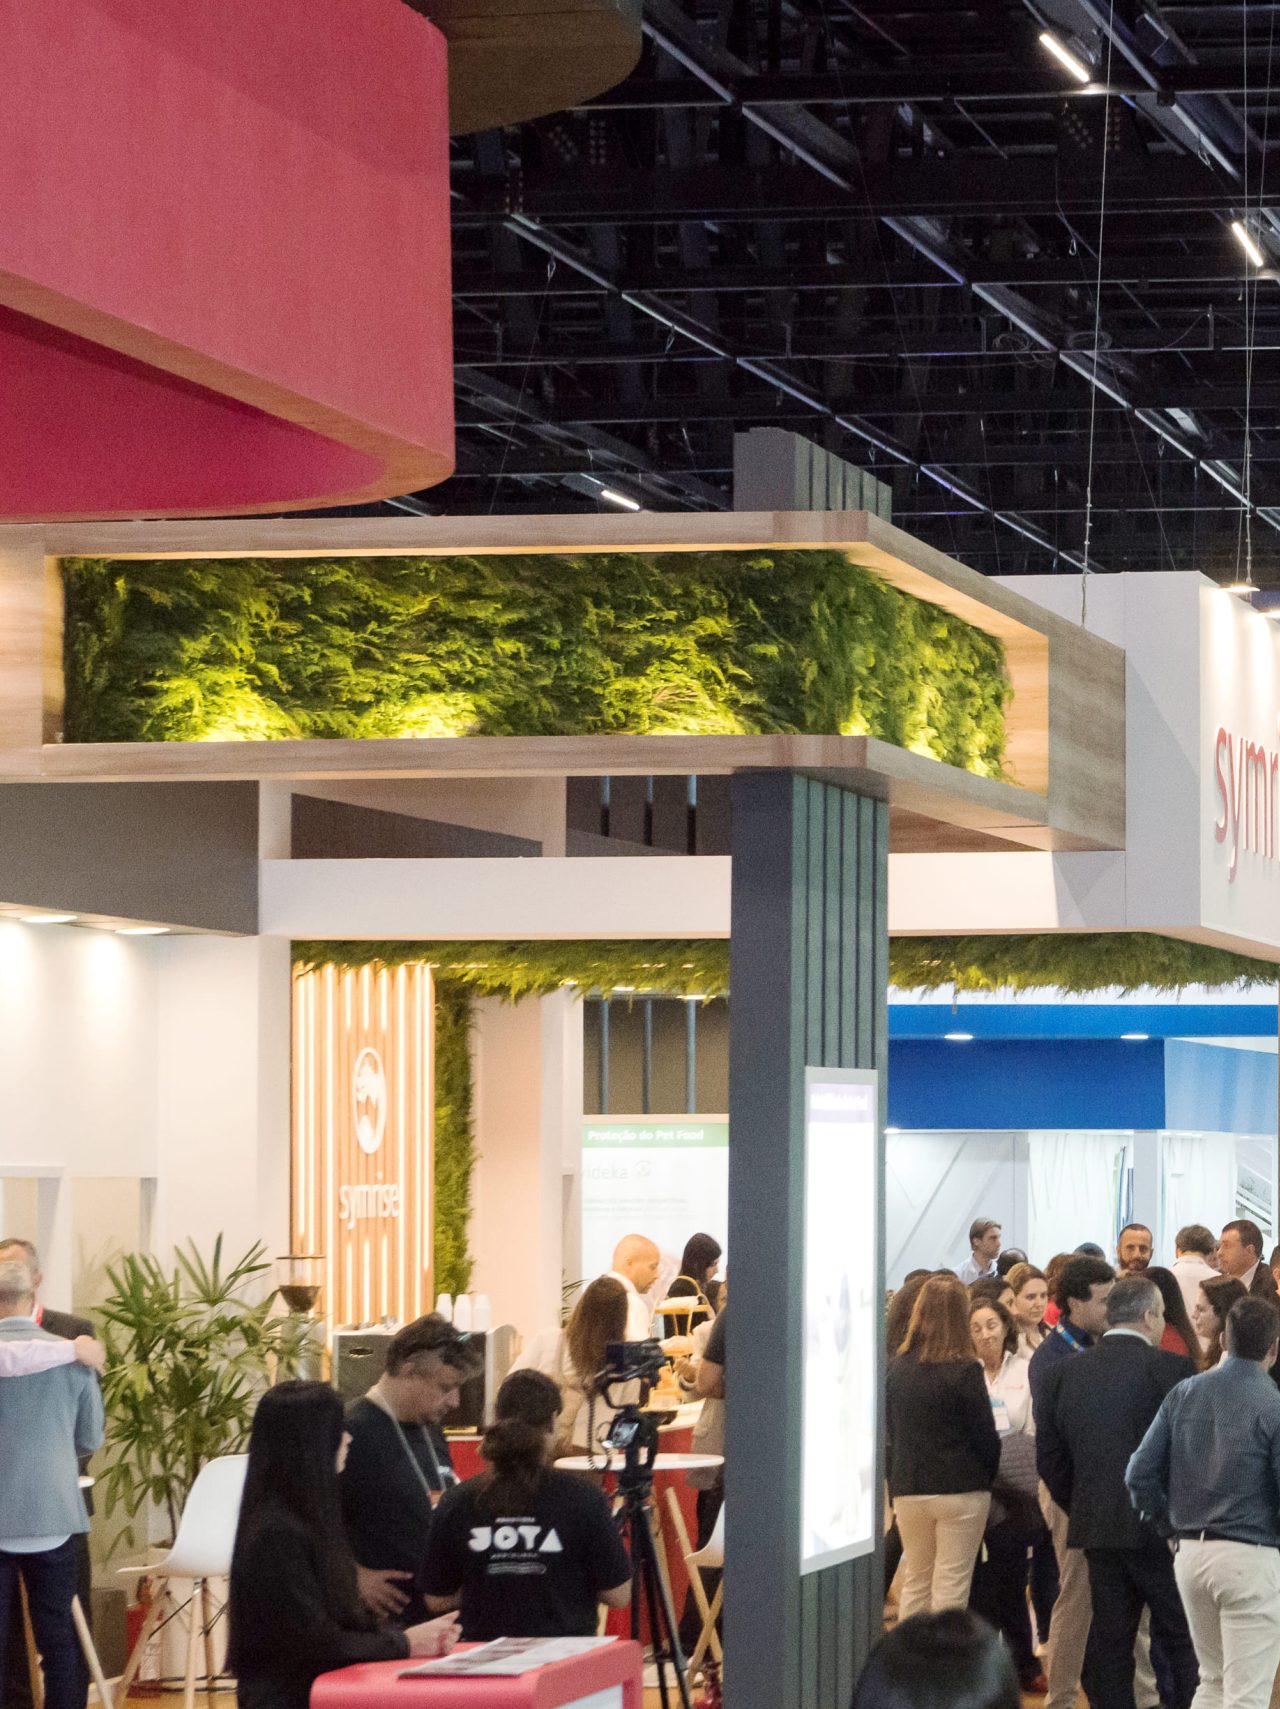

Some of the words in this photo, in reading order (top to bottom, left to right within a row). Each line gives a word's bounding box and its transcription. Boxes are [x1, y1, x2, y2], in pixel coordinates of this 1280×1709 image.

[639, 1130, 654, 1141] do
[339, 1169, 400, 1230] symrise
[467, 1525, 564, 1553] JOTA
